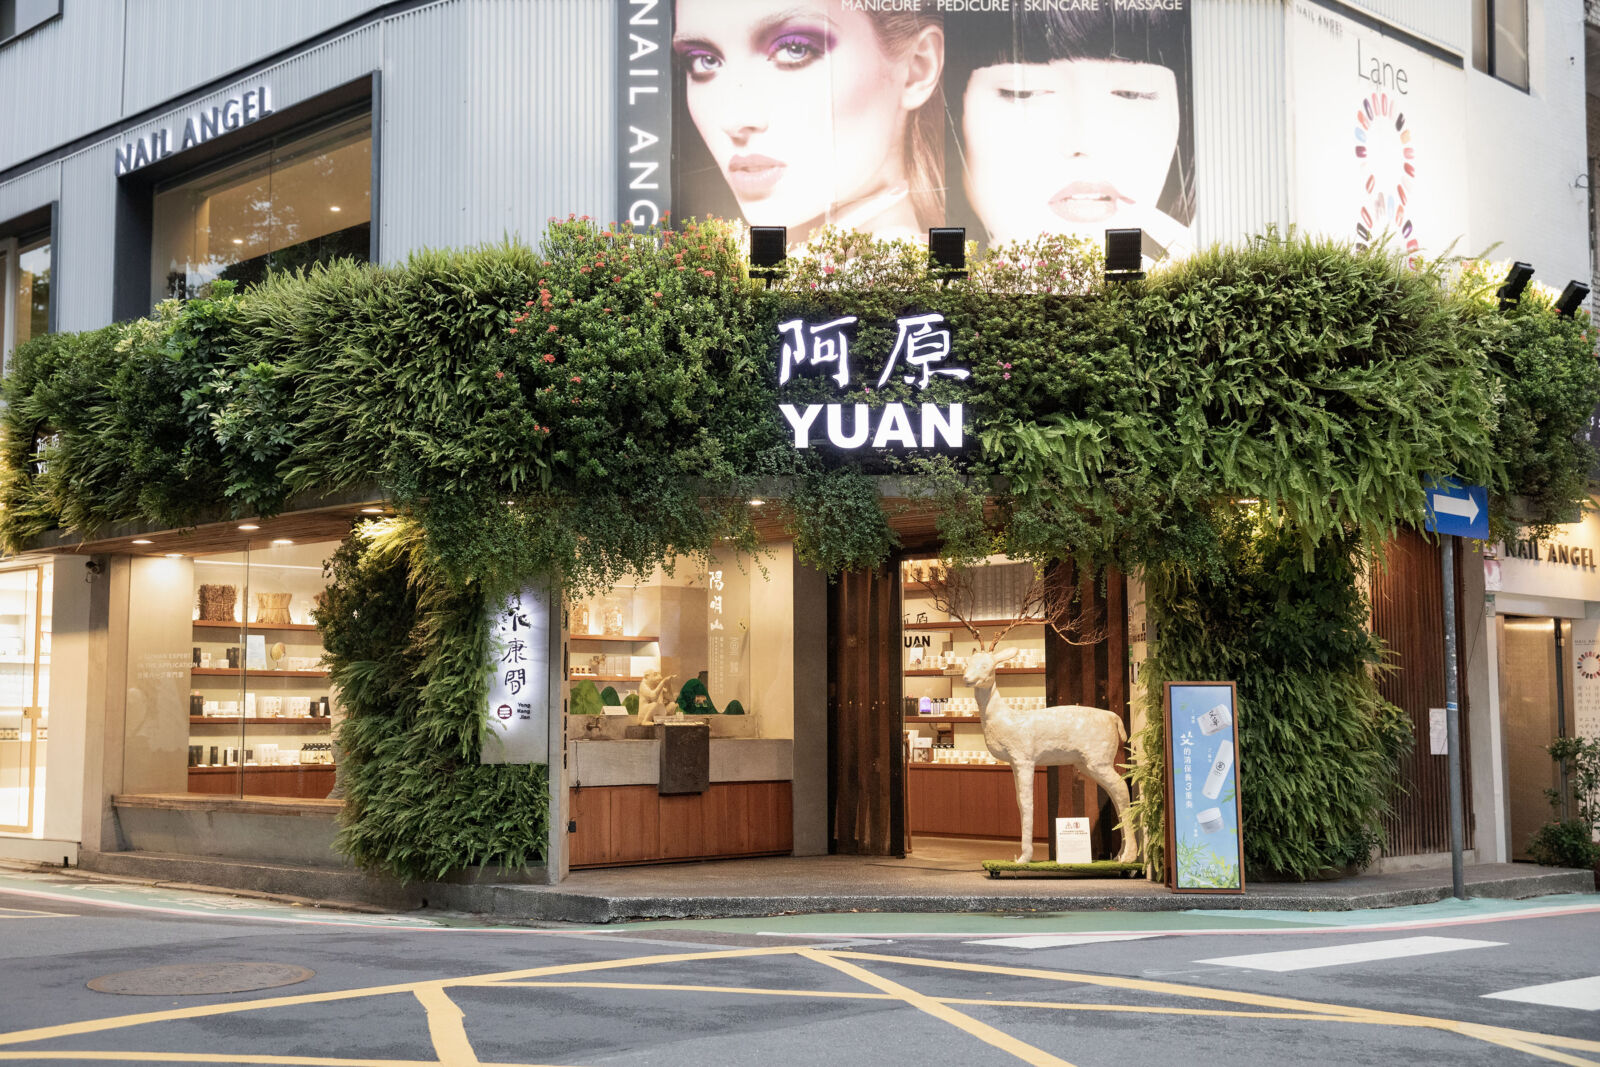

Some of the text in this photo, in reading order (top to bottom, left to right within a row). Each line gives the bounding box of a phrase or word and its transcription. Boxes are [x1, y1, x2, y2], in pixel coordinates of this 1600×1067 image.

[841, 0, 1183, 12] MANICURE PEDICURE SKINCARE MASSAGE
[1357, 38, 1408, 95] Lane
[115, 86, 273, 177] NAIL ANGEL
[629, 0, 658, 238] NAIL ANG
[778, 313, 970, 390] 阿原
[778, 403, 963, 449] YUAN
[1504, 540, 1597, 568] NAIL ANGEL
[708, 570, 725, 631] 陽明山
[904, 635, 931, 648] UAN
